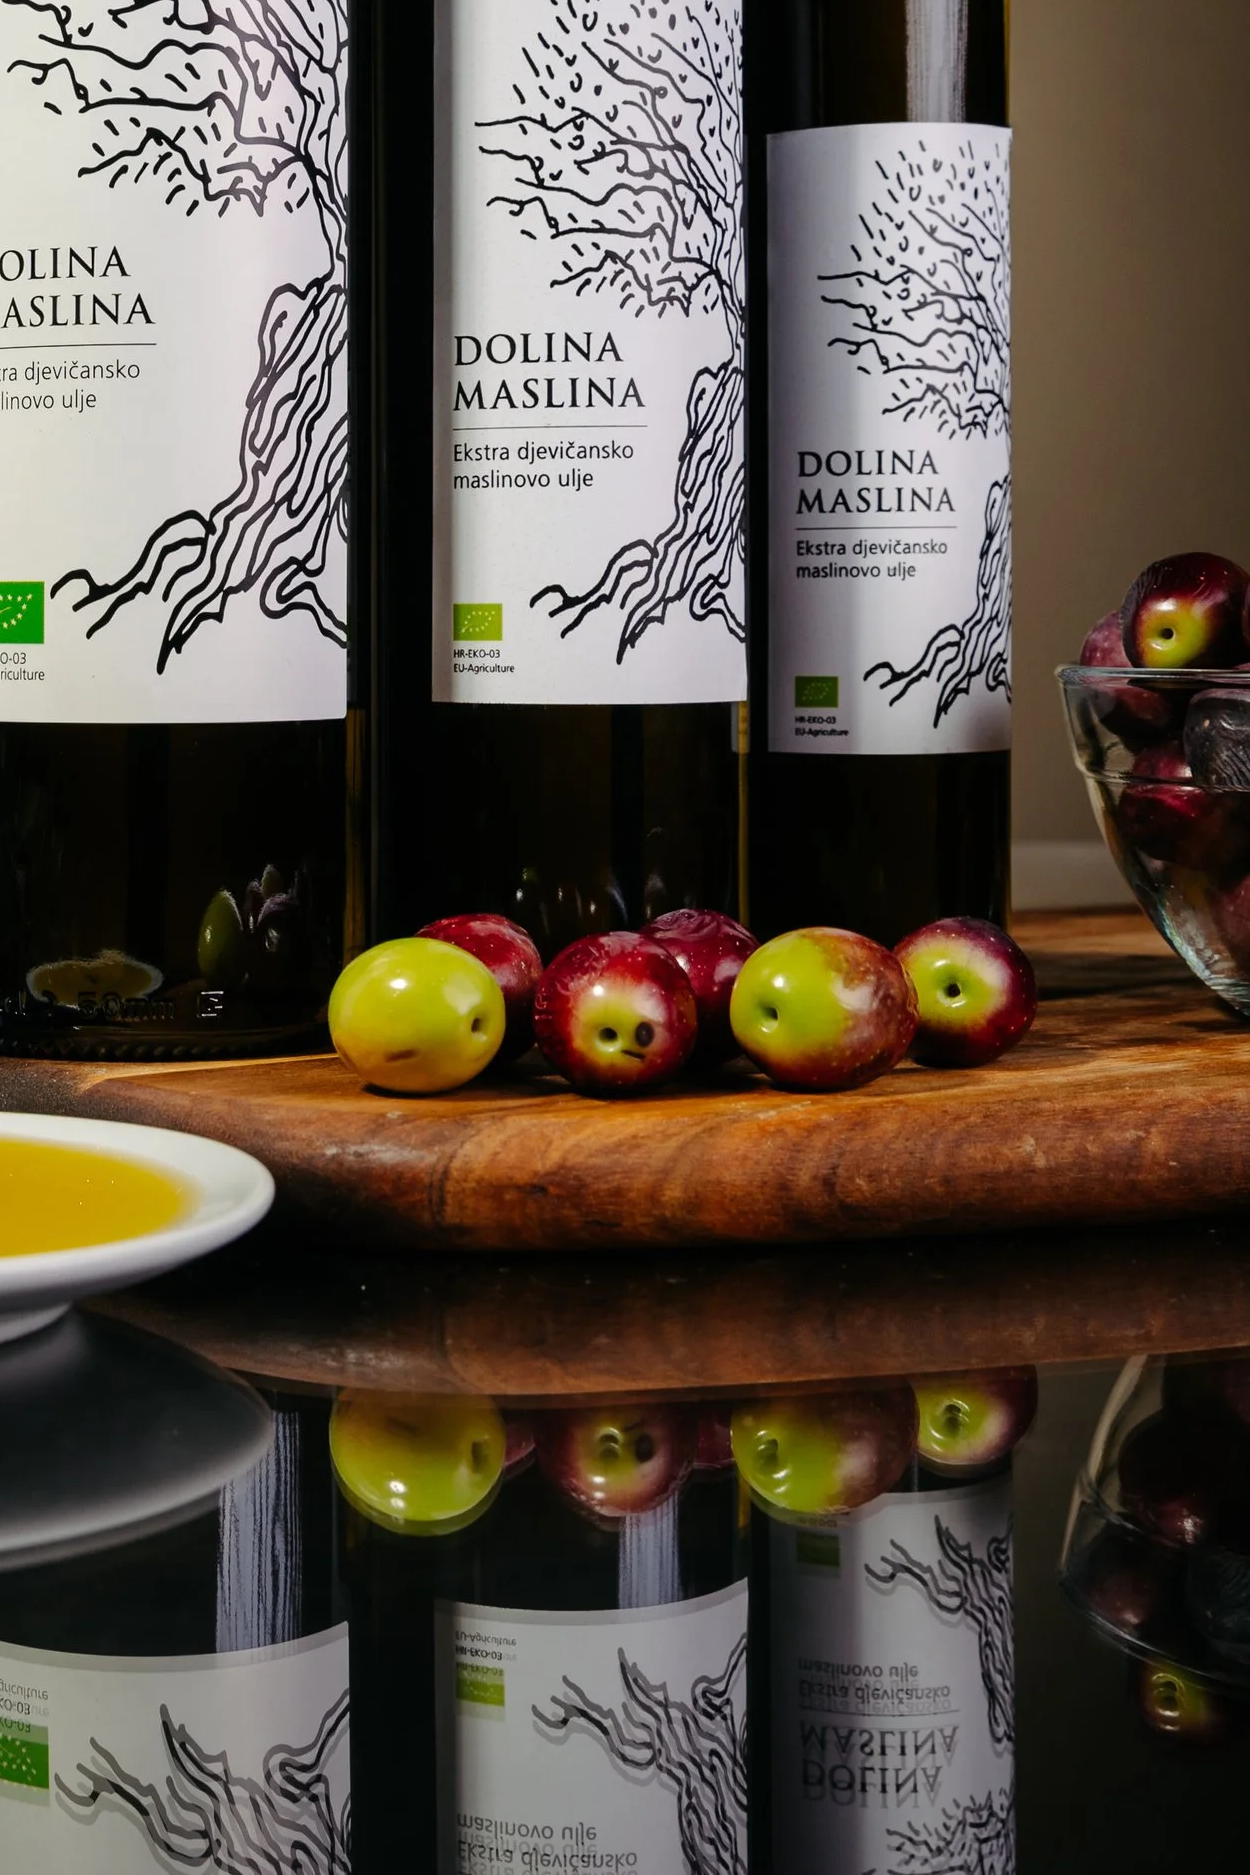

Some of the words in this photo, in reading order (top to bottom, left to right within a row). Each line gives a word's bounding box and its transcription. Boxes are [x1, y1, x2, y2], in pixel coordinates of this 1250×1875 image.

[454, 331, 624, 367] DOLINA
[24, 360, 141, 385] djevičansko
[62, 390, 97, 413] ulje
[452, 377, 646, 411] MASLINA
[453, 441, 510, 462] Ekstra
[517, 439, 634, 464] djevičansko
[797, 450, 939, 477] DOLINA
[453, 470, 551, 489] maslinovo
[558, 468, 594, 491] ulje
[796, 487, 956, 514] MASLINA
[796, 538, 847, 556] Ekstra
[852, 538, 948, 558] djevičansko
[796, 563, 881, 579] maslinovo
[886, 562, 917, 580] ulje
[453, 649, 501, 659] HR-EKO-03
[453, 663, 515, 674] EU-Agriculture
